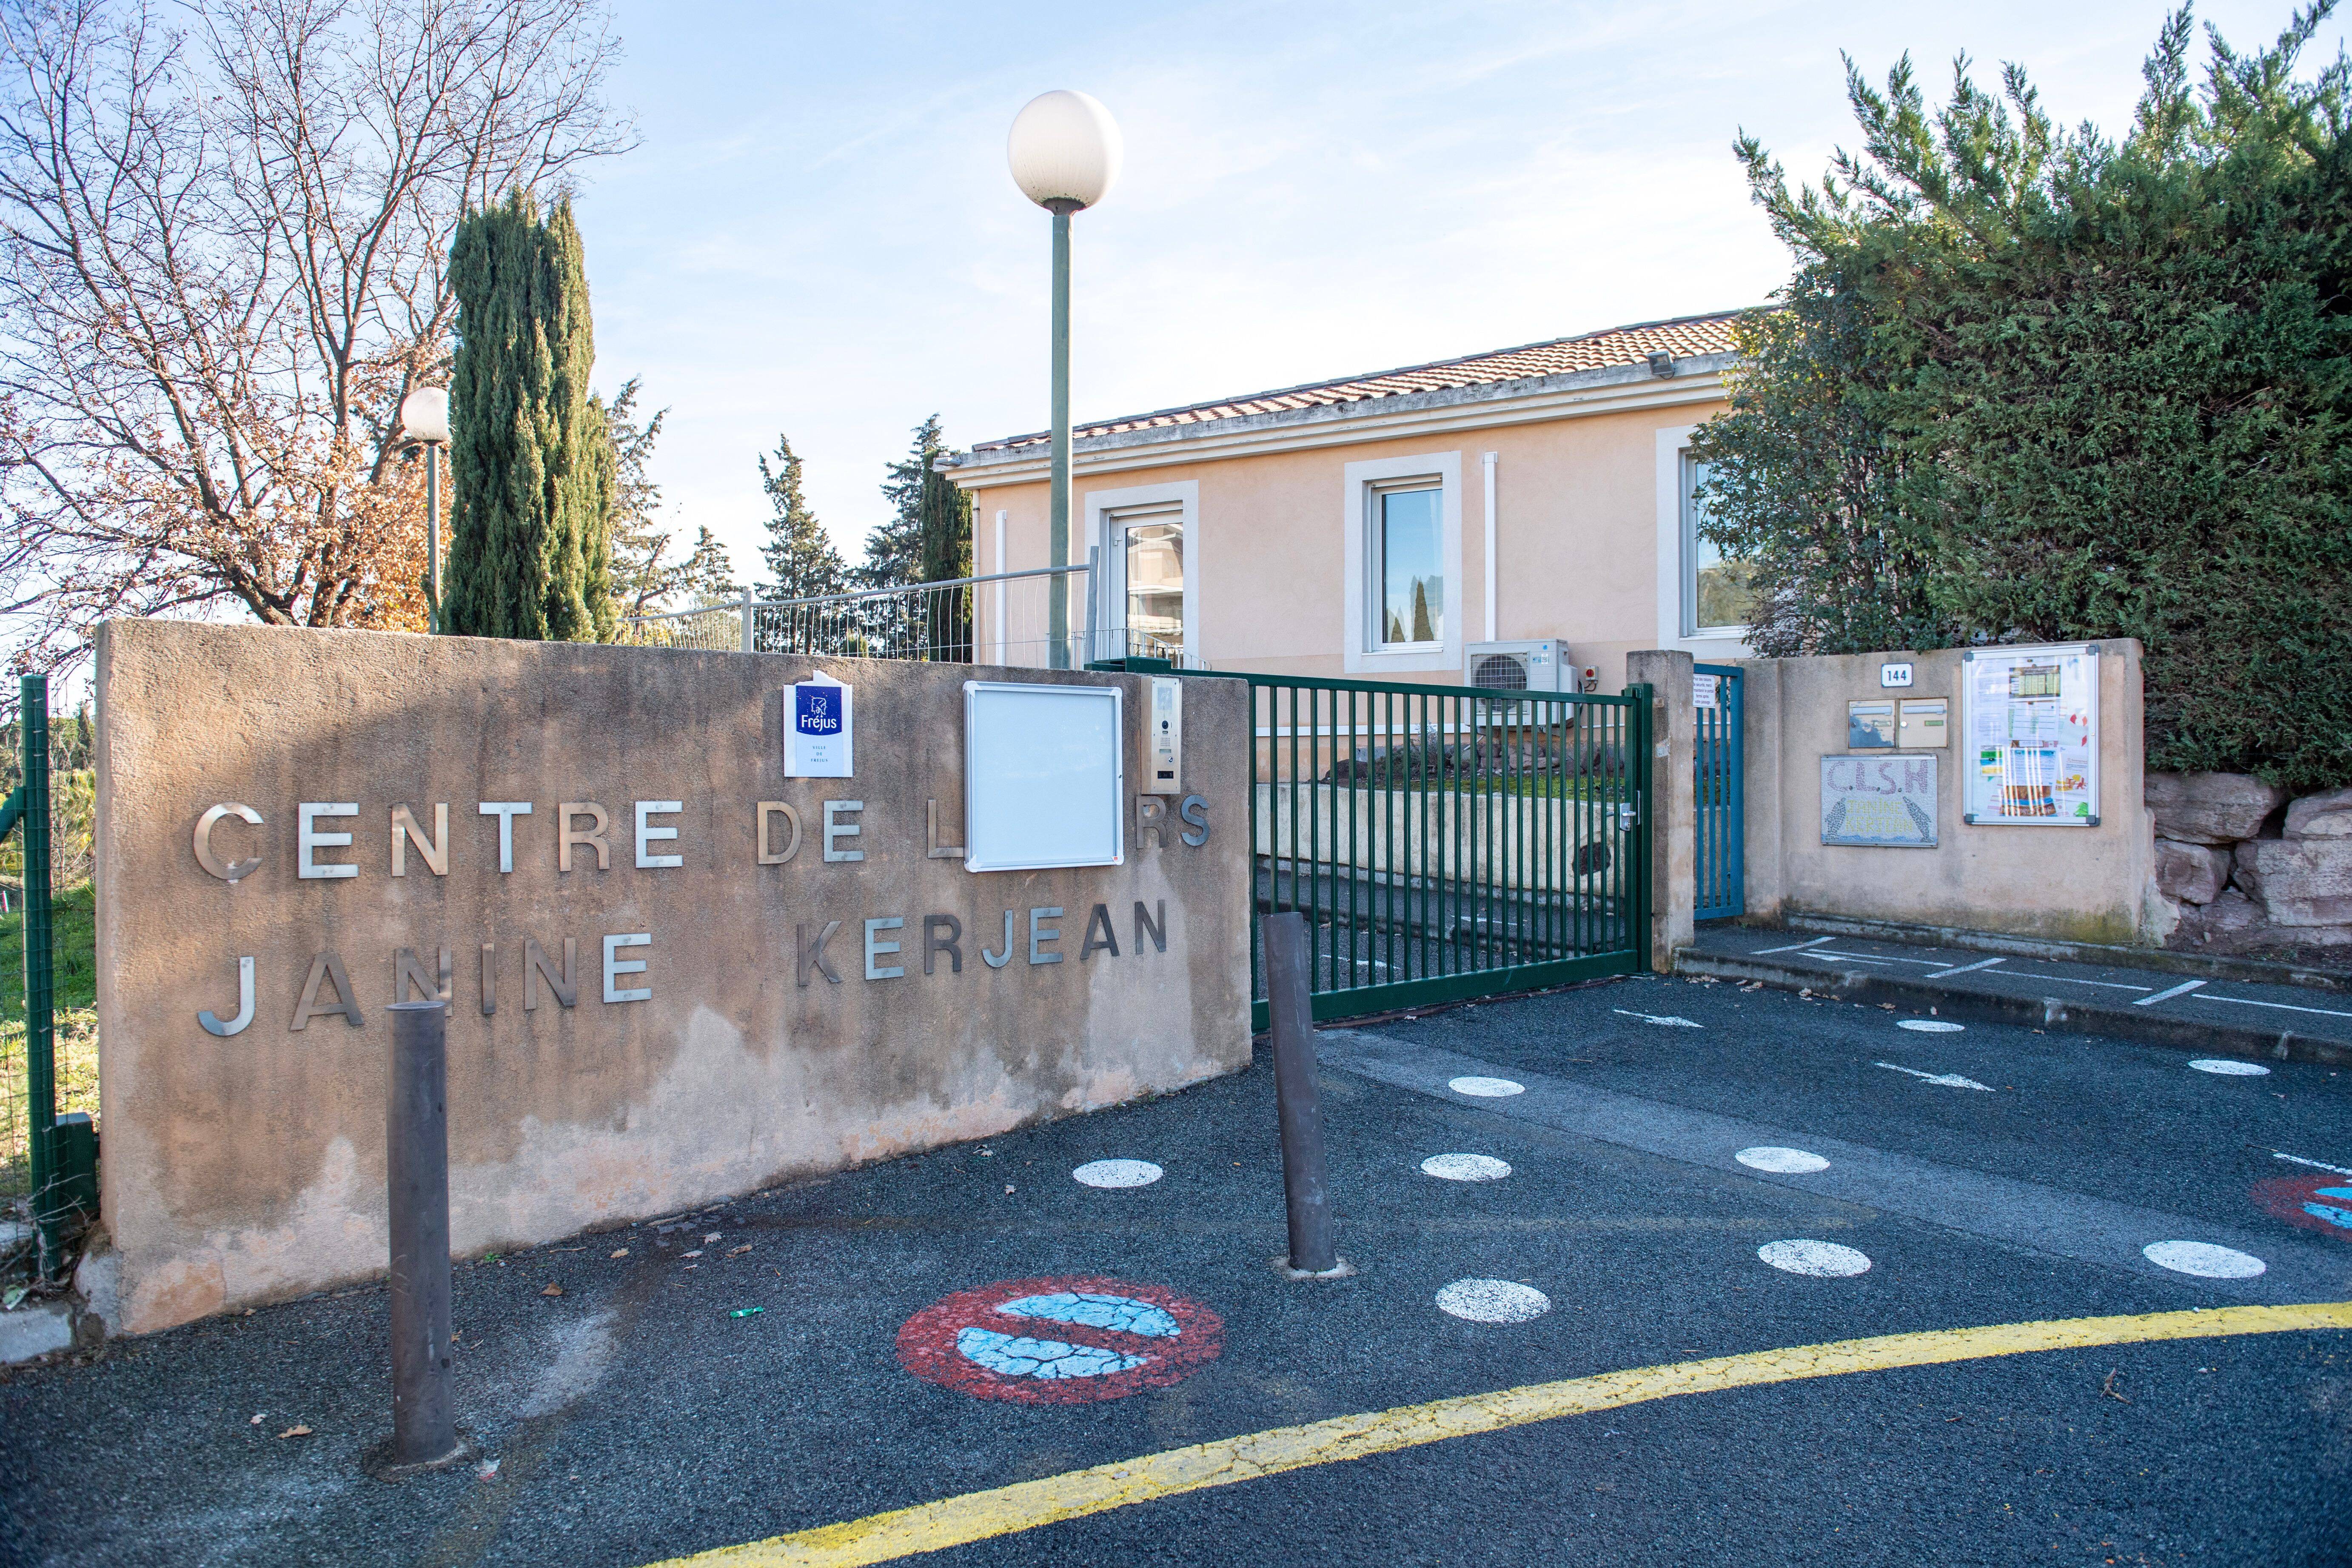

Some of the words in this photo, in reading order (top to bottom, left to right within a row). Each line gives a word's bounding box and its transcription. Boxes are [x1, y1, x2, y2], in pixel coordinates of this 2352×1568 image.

[1887, 670, 1907, 681] 144
[801, 715, 837, 732] Fréjus
[193, 800, 683, 881] CENTRE
[757, 800, 864, 865] DE
[197, 933, 652, 1037] JANINE
[796, 899, 1166, 986] KERJEAN
